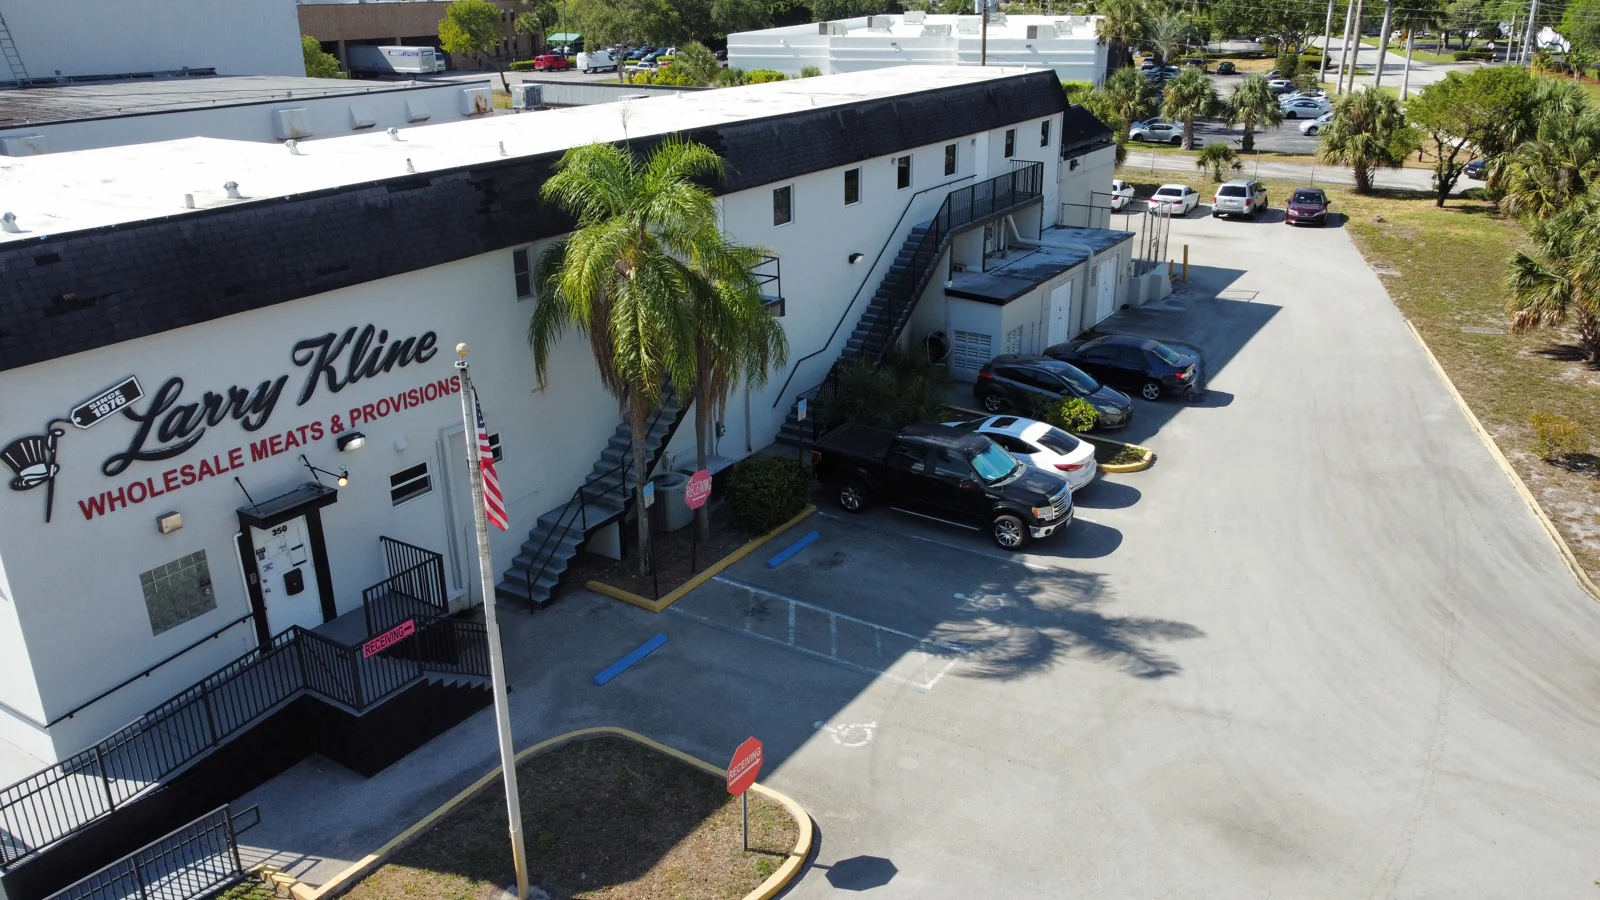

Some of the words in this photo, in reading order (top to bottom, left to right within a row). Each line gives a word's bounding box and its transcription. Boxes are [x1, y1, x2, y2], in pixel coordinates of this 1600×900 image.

[88, 389, 122, 410] SINCE
[91, 395, 126, 418] 1976
[103, 375, 288, 477] Larry
[292, 323, 438, 406] Kline
[78, 447, 245, 521] WHOLESALE
[250, 421, 324, 463] MEATS
[331, 414, 345, 435] &
[349, 375, 461, 429] PROVISIONS
[271, 525, 288, 537] 350
[364, 626, 405, 656] RECEIVING
[729, 747, 761, 780] RECEIVING
